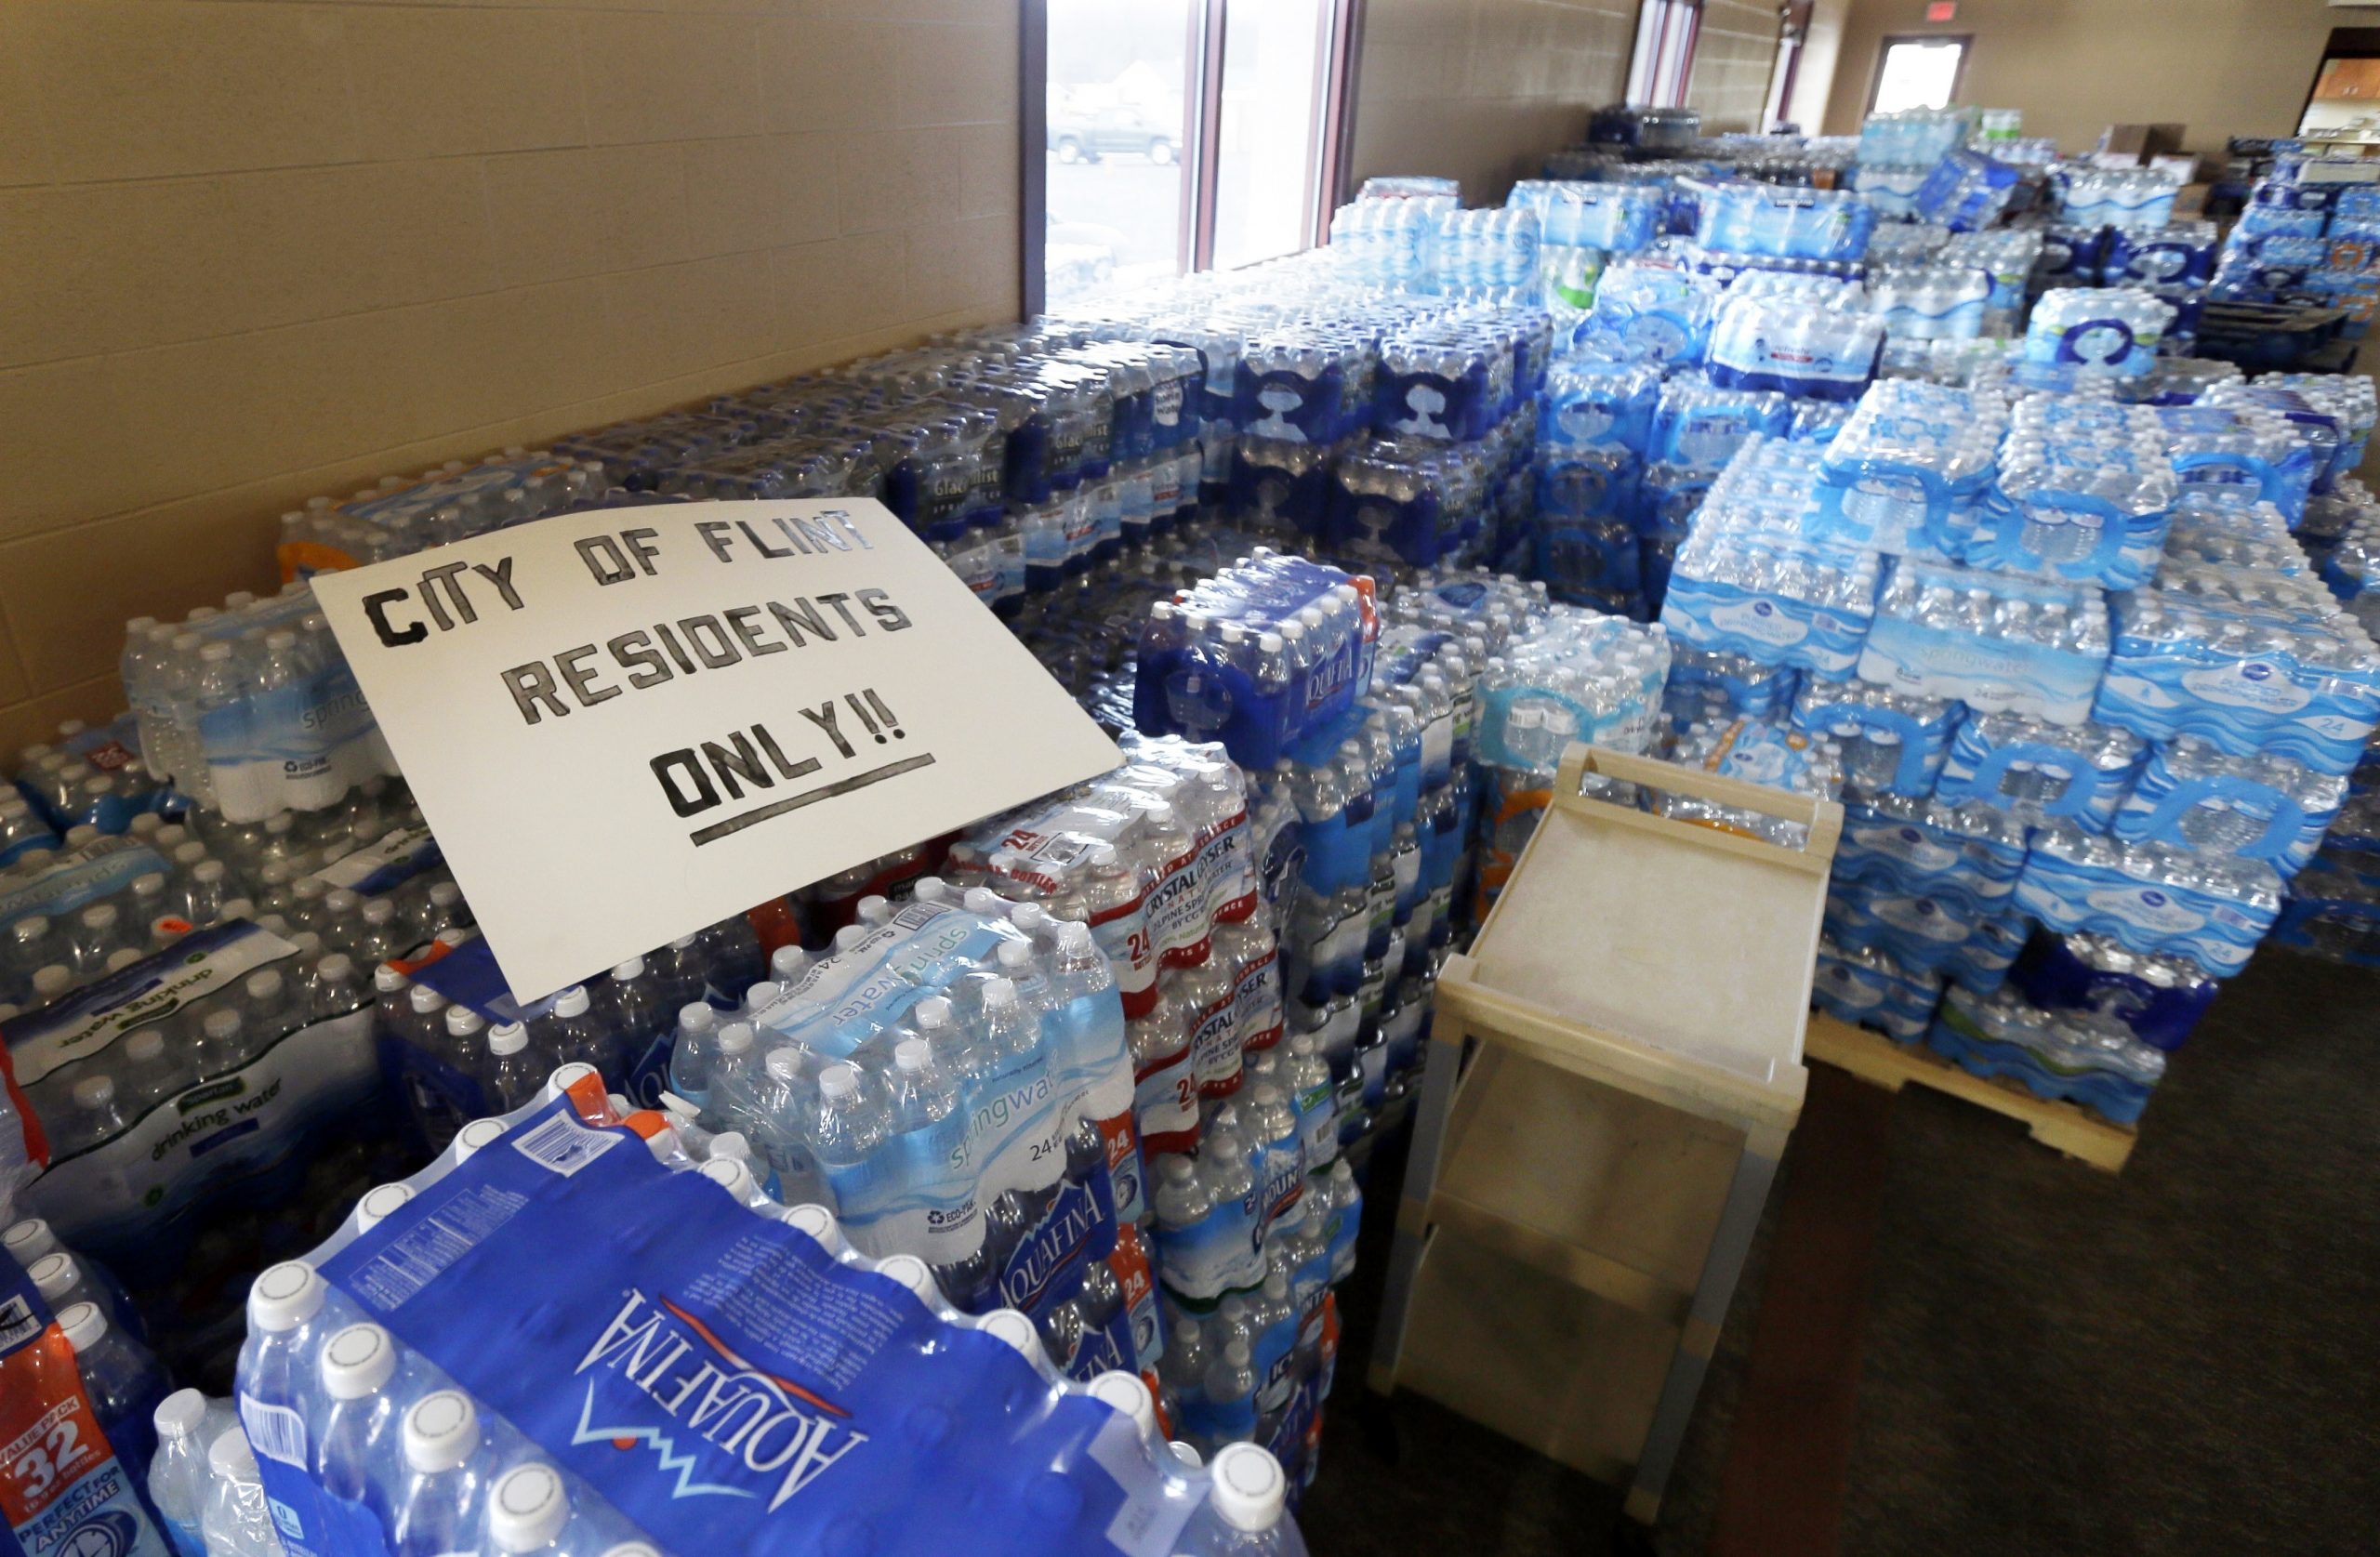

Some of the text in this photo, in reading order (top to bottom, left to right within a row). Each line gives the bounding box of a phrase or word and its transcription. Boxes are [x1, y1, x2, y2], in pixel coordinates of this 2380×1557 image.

[361, 509, 875, 648] CITY OF FLINT
[499, 587, 913, 726] RESIDENTS
[649, 688, 907, 818] ONLY!!
[2318, 717, 2346, 735] 24
[1127, 924, 1151, 962] 24
[1028, 1139, 1052, 1162] 24
[1107, 1128, 1130, 1160] 24
[998, 1180, 1105, 1311] AQUAFINA
[1123, 1269, 1146, 1300] 24
[574, 1287, 869, 1515] AQUAFINA
[14, 1419, 90, 1498] 32
[18, 1465, 121, 1544] PERFECT FOR
[35, 1480, 121, 1554] ANYTIME
